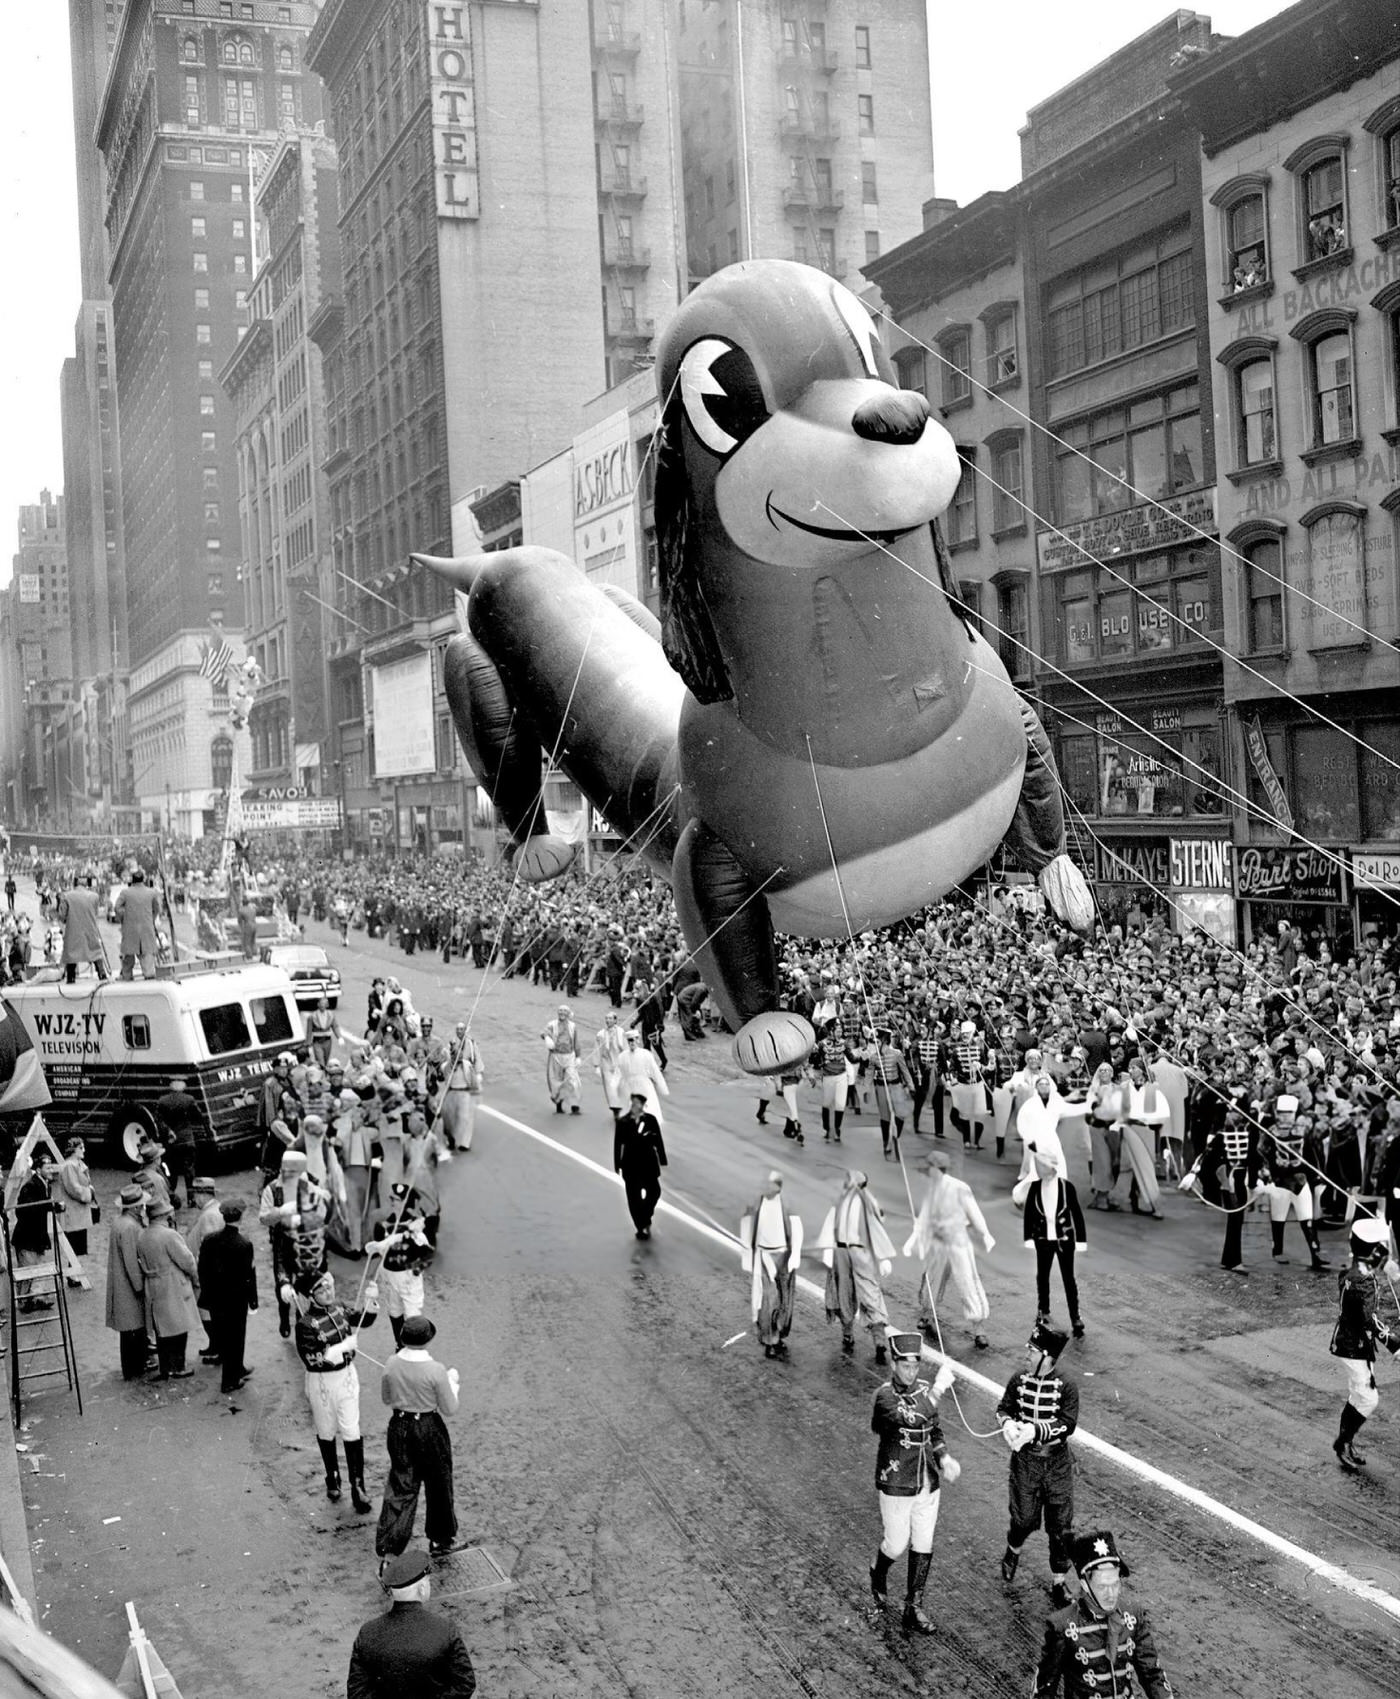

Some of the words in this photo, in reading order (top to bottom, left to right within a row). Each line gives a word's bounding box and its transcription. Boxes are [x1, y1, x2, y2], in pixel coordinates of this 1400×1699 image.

[434, 6, 469, 207] HOTEL
[1238, 301, 1274, 337] ALL
[1246, 478, 1291, 513] AND
[1301, 464, 1346, 503] ALL
[1354, 447, 1400, 490] PAI
[1184, 601, 1208, 624] CO.
[1097, 723, 1122, 733] SALON
[1153, 717, 1180, 730] SALON
[1249, 730, 1291, 828] ENTRANCE
[259, 787, 308, 800] SAVOY
[1171, 839, 1233, 888] STERNS
[1296, 849, 1338, 886] Shop
[42, 1041, 100, 1054] TELEVISION
[52, 1065, 82, 1073] AMERICAN
[217, 1067, 242, 1082] WJZ
[53, 1077, 91, 1085] BROADCASING
